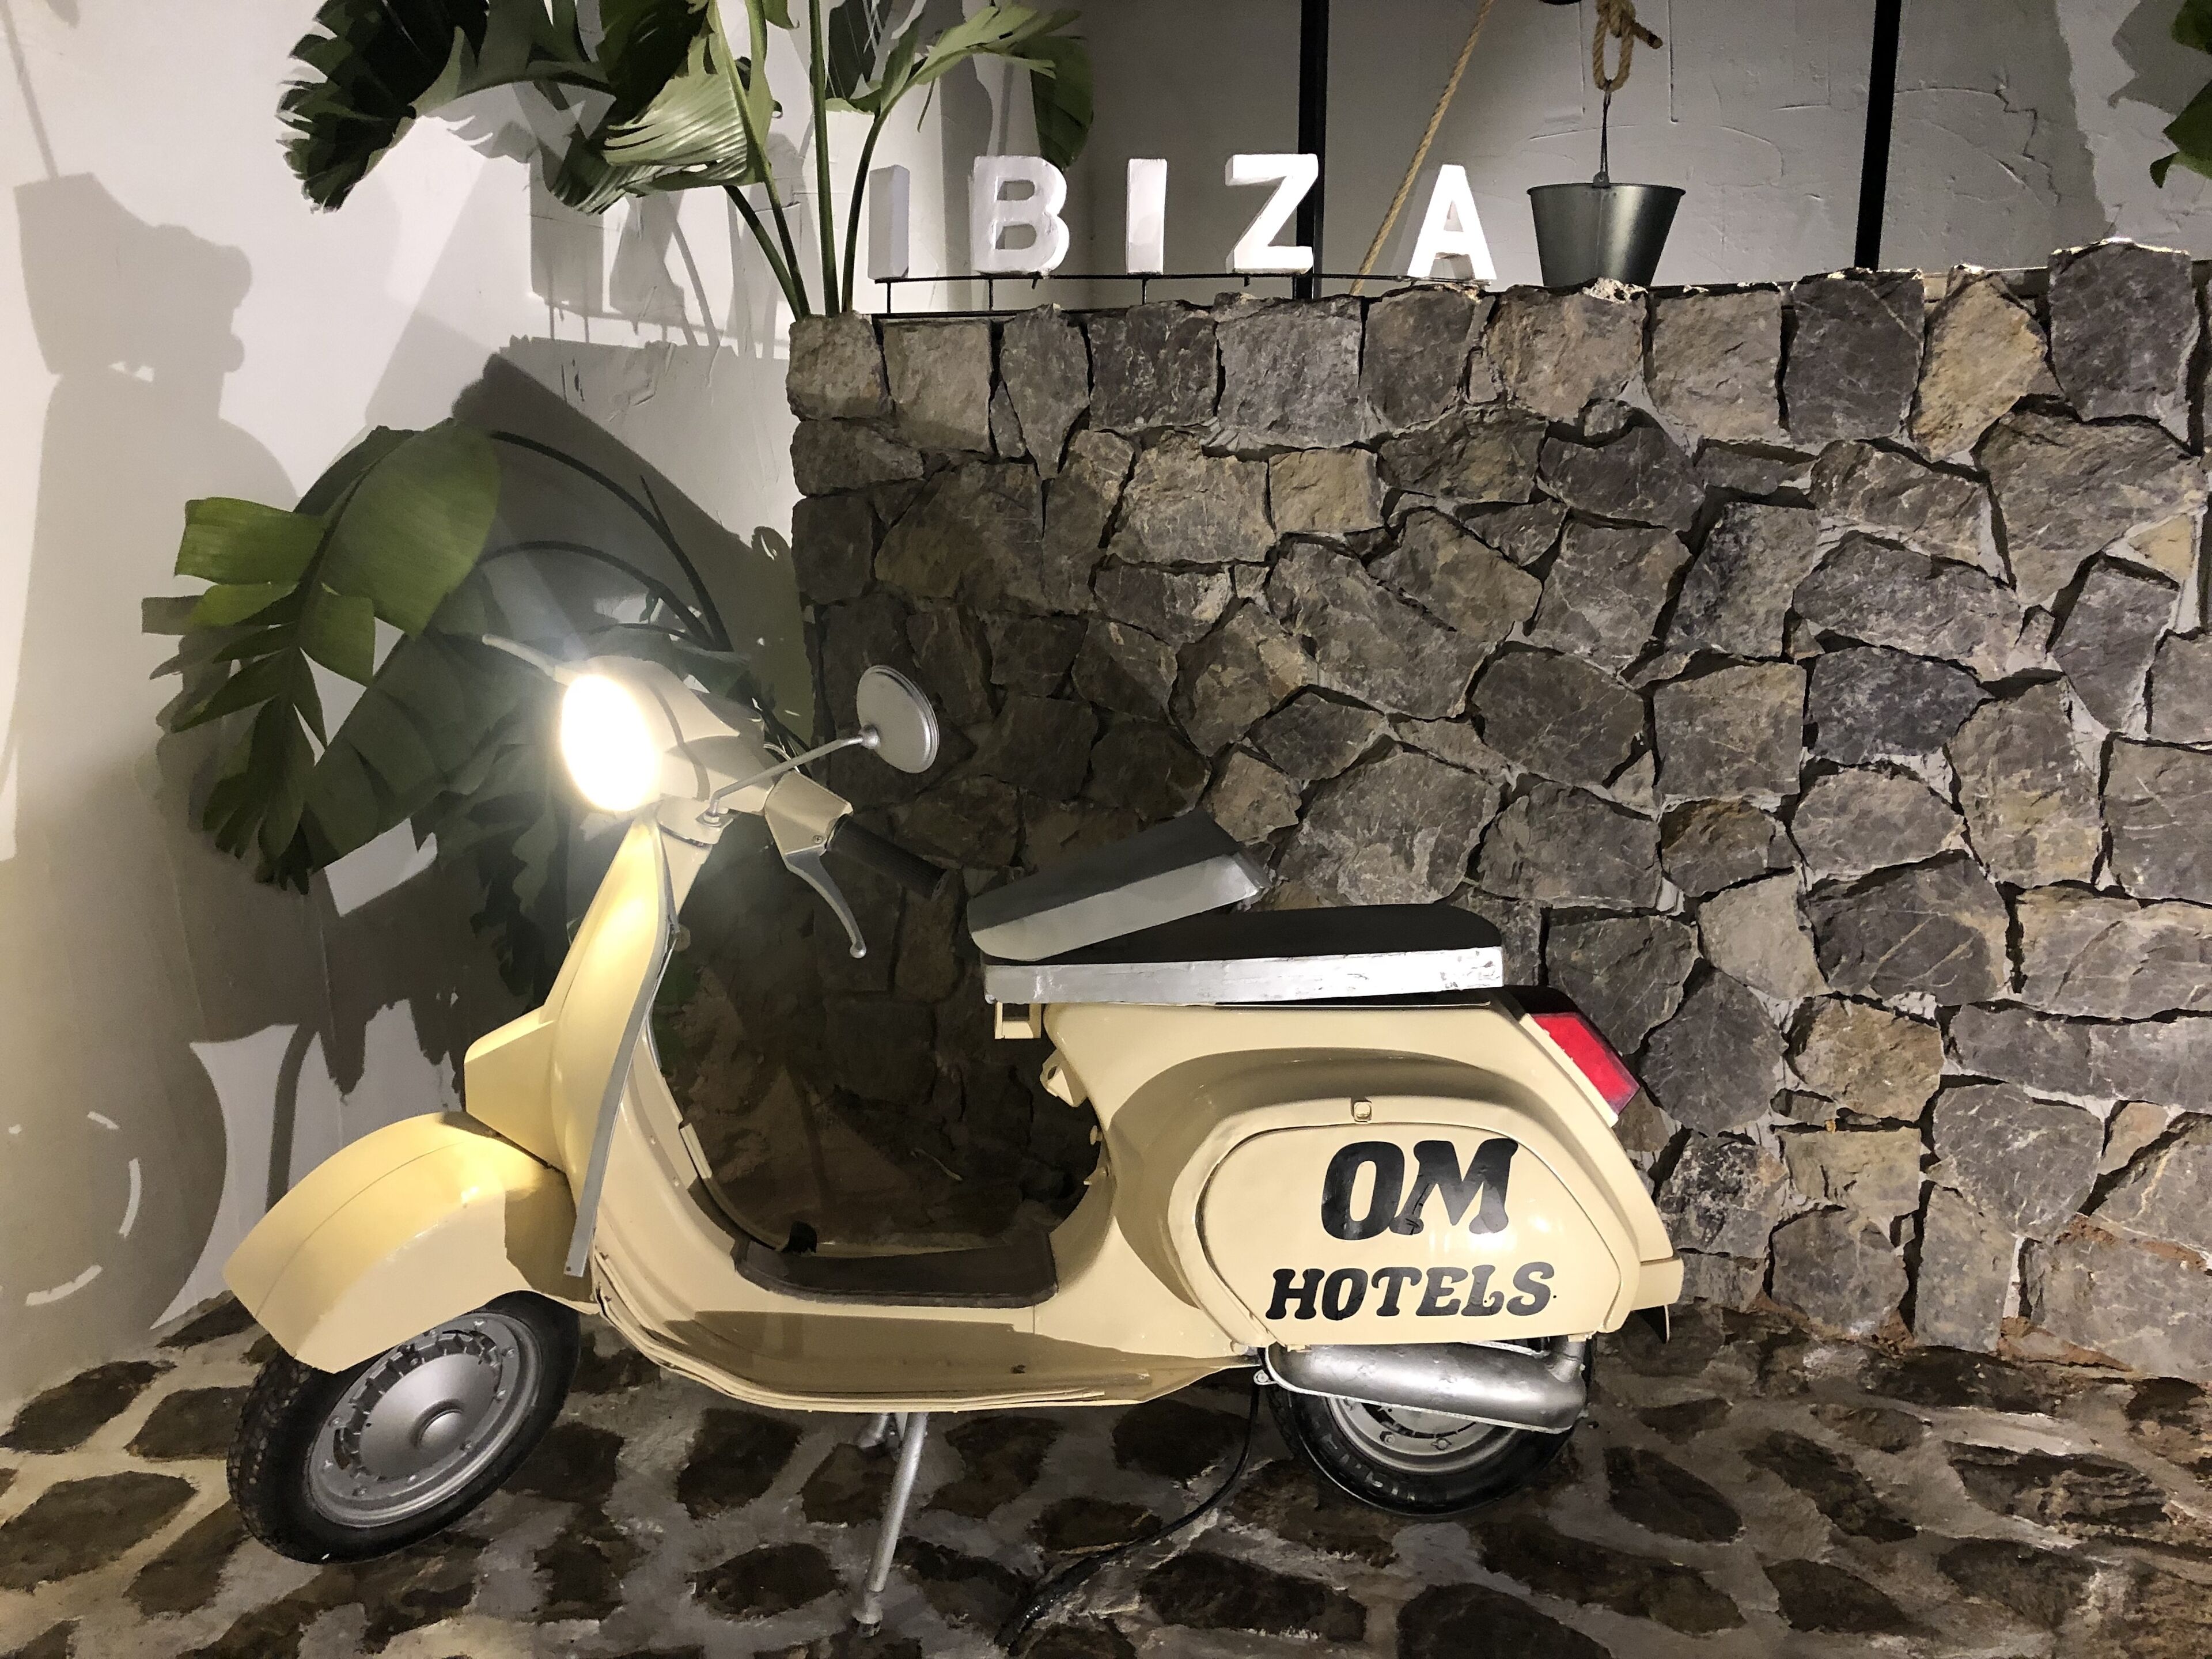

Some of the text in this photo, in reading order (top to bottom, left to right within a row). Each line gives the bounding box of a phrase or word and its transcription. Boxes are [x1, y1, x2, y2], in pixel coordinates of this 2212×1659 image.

[868, 154, 1496, 279] IBIZA
[1322, 1139, 1518, 1240] OM
[1266, 1262, 1554, 1320] HOTELS
